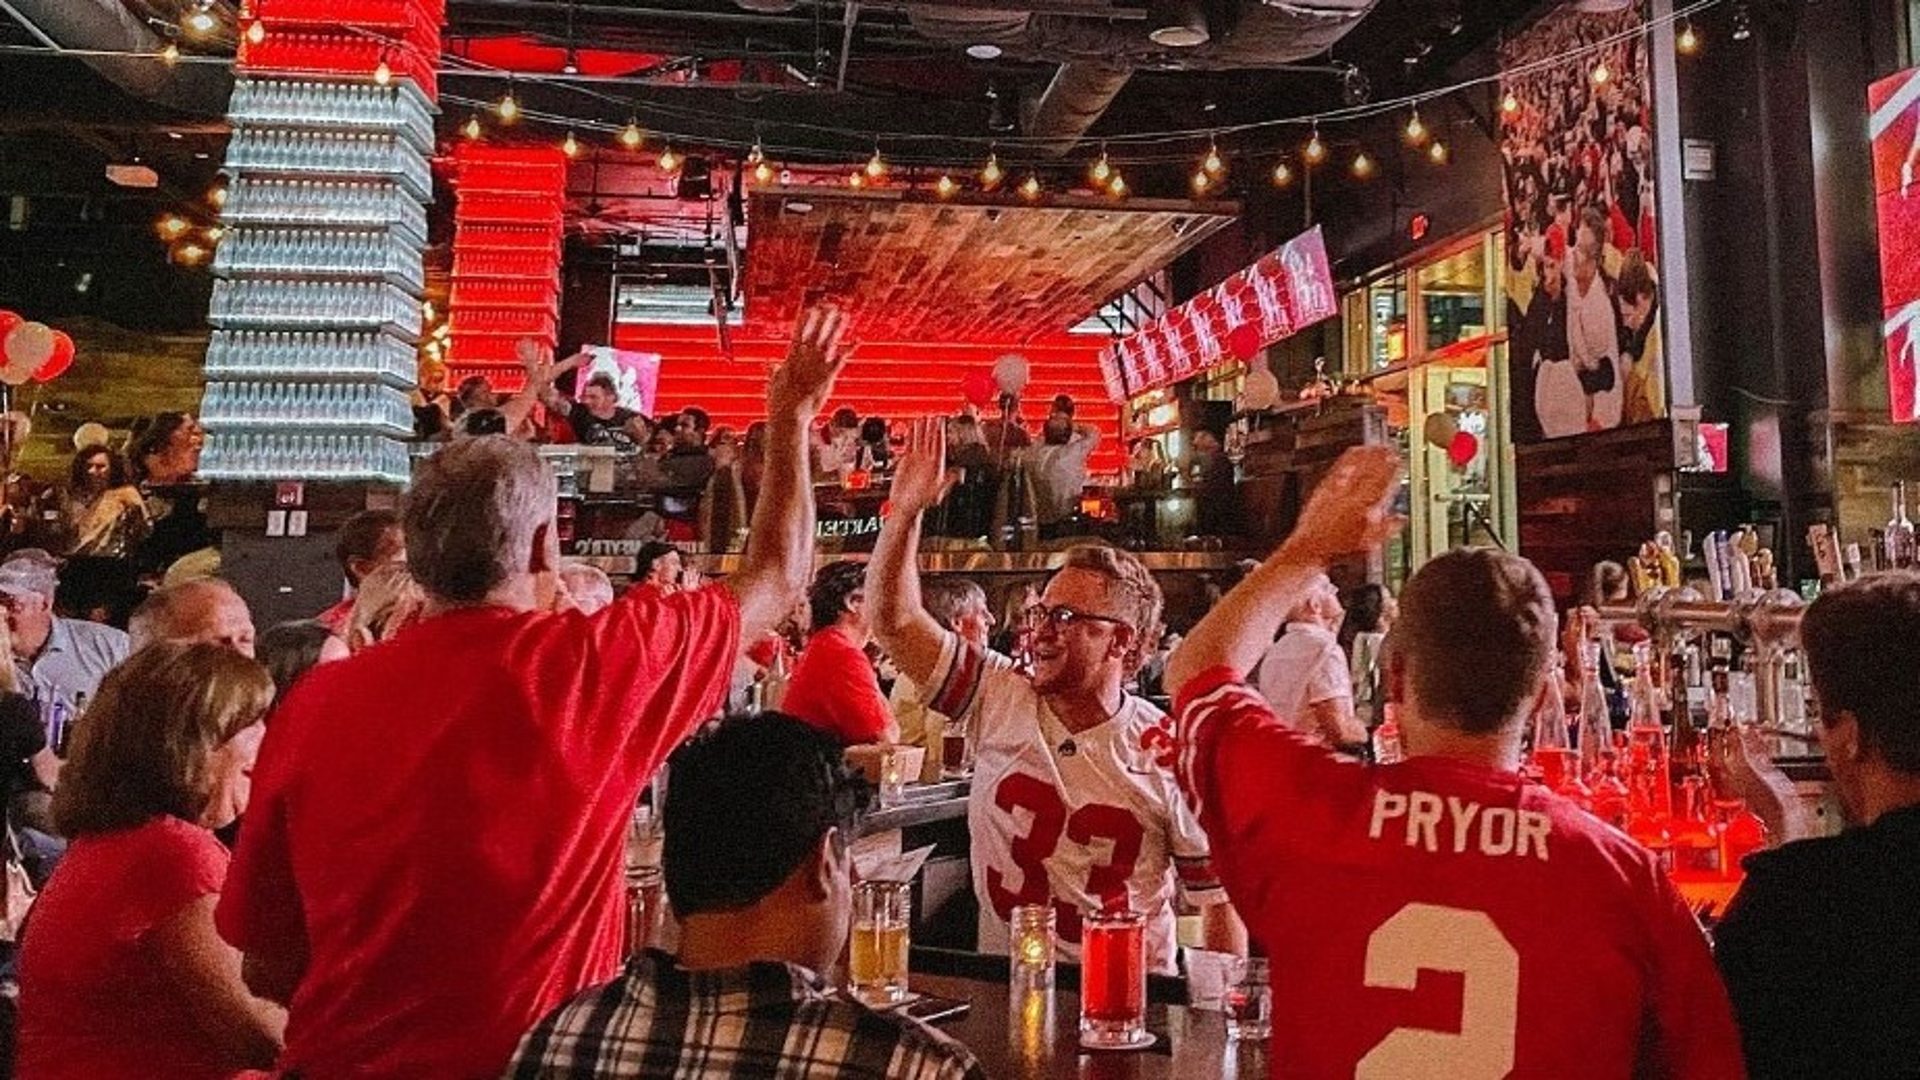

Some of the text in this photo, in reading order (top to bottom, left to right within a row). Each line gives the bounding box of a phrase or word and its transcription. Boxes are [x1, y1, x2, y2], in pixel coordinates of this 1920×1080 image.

[987, 772, 1143, 943] 33
[1369, 789, 1552, 861] PRYOR
[1354, 902, 1519, 1080] 2
